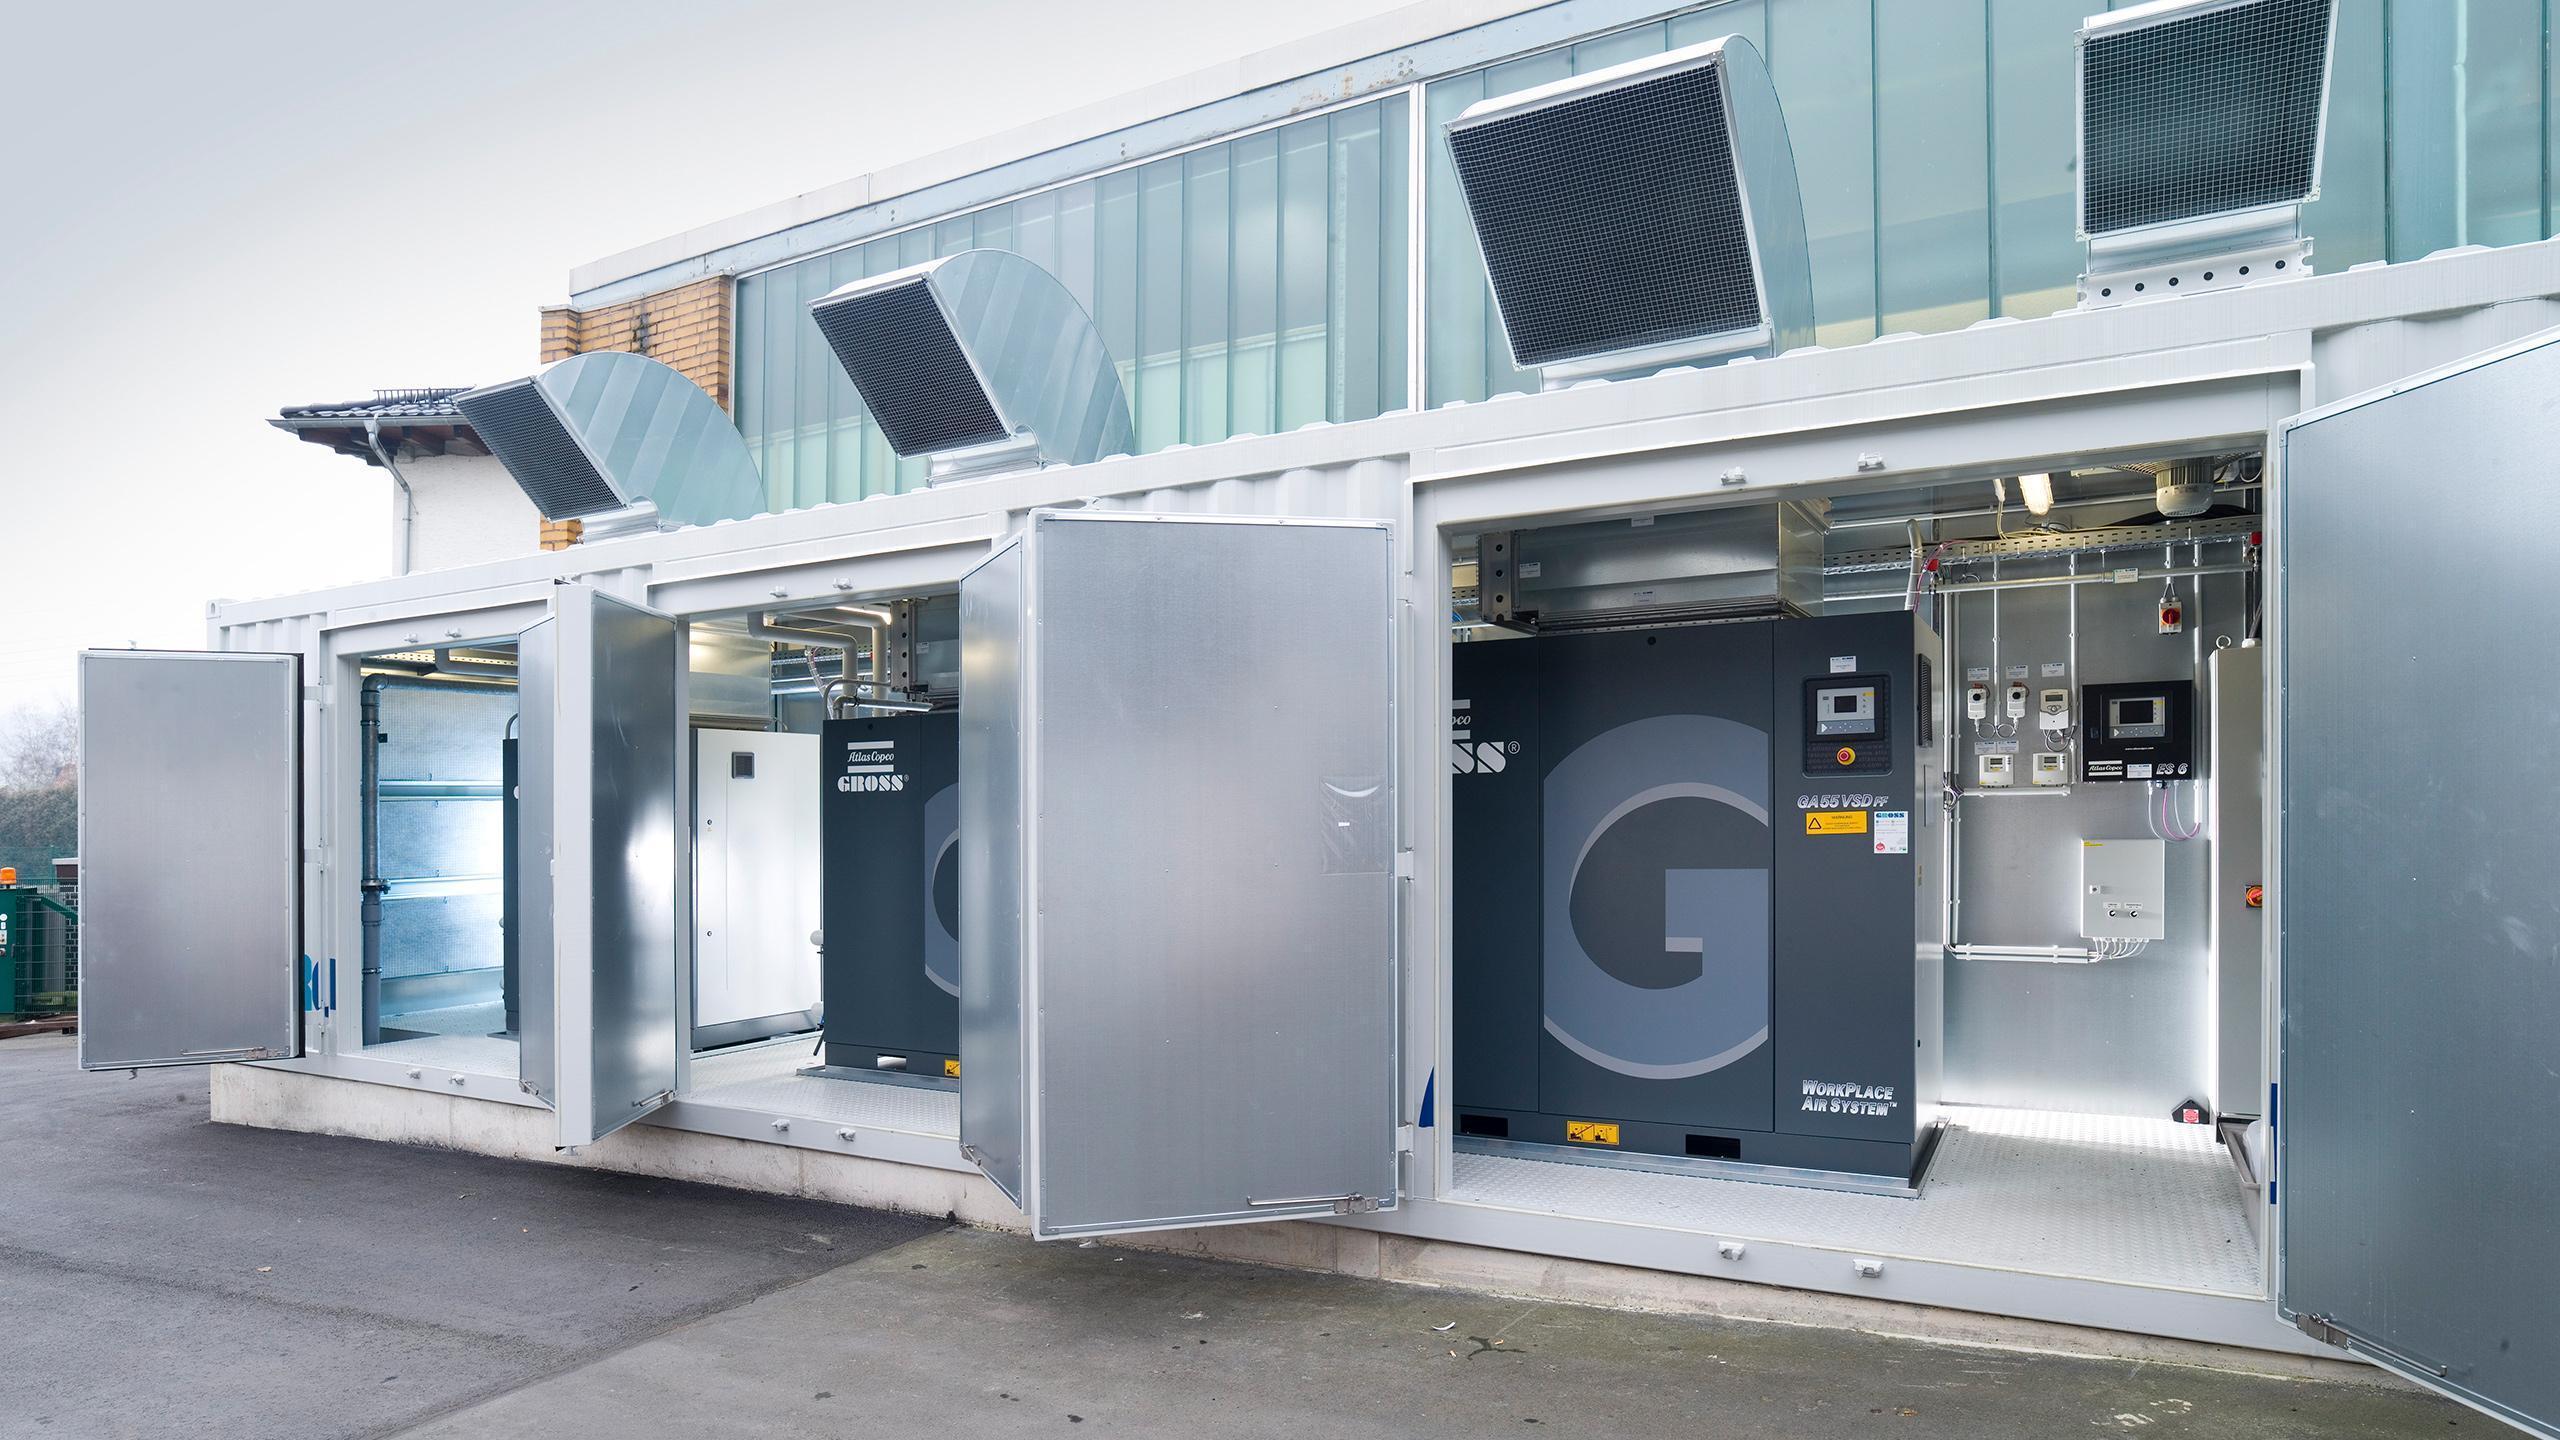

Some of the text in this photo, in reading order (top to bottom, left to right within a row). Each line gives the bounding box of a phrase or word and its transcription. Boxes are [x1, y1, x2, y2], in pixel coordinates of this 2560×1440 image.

[848, 750, 895, 764] Atlas Copco
[2156, 763, 2175, 775] ES
[2177, 763, 2189, 775] 6
